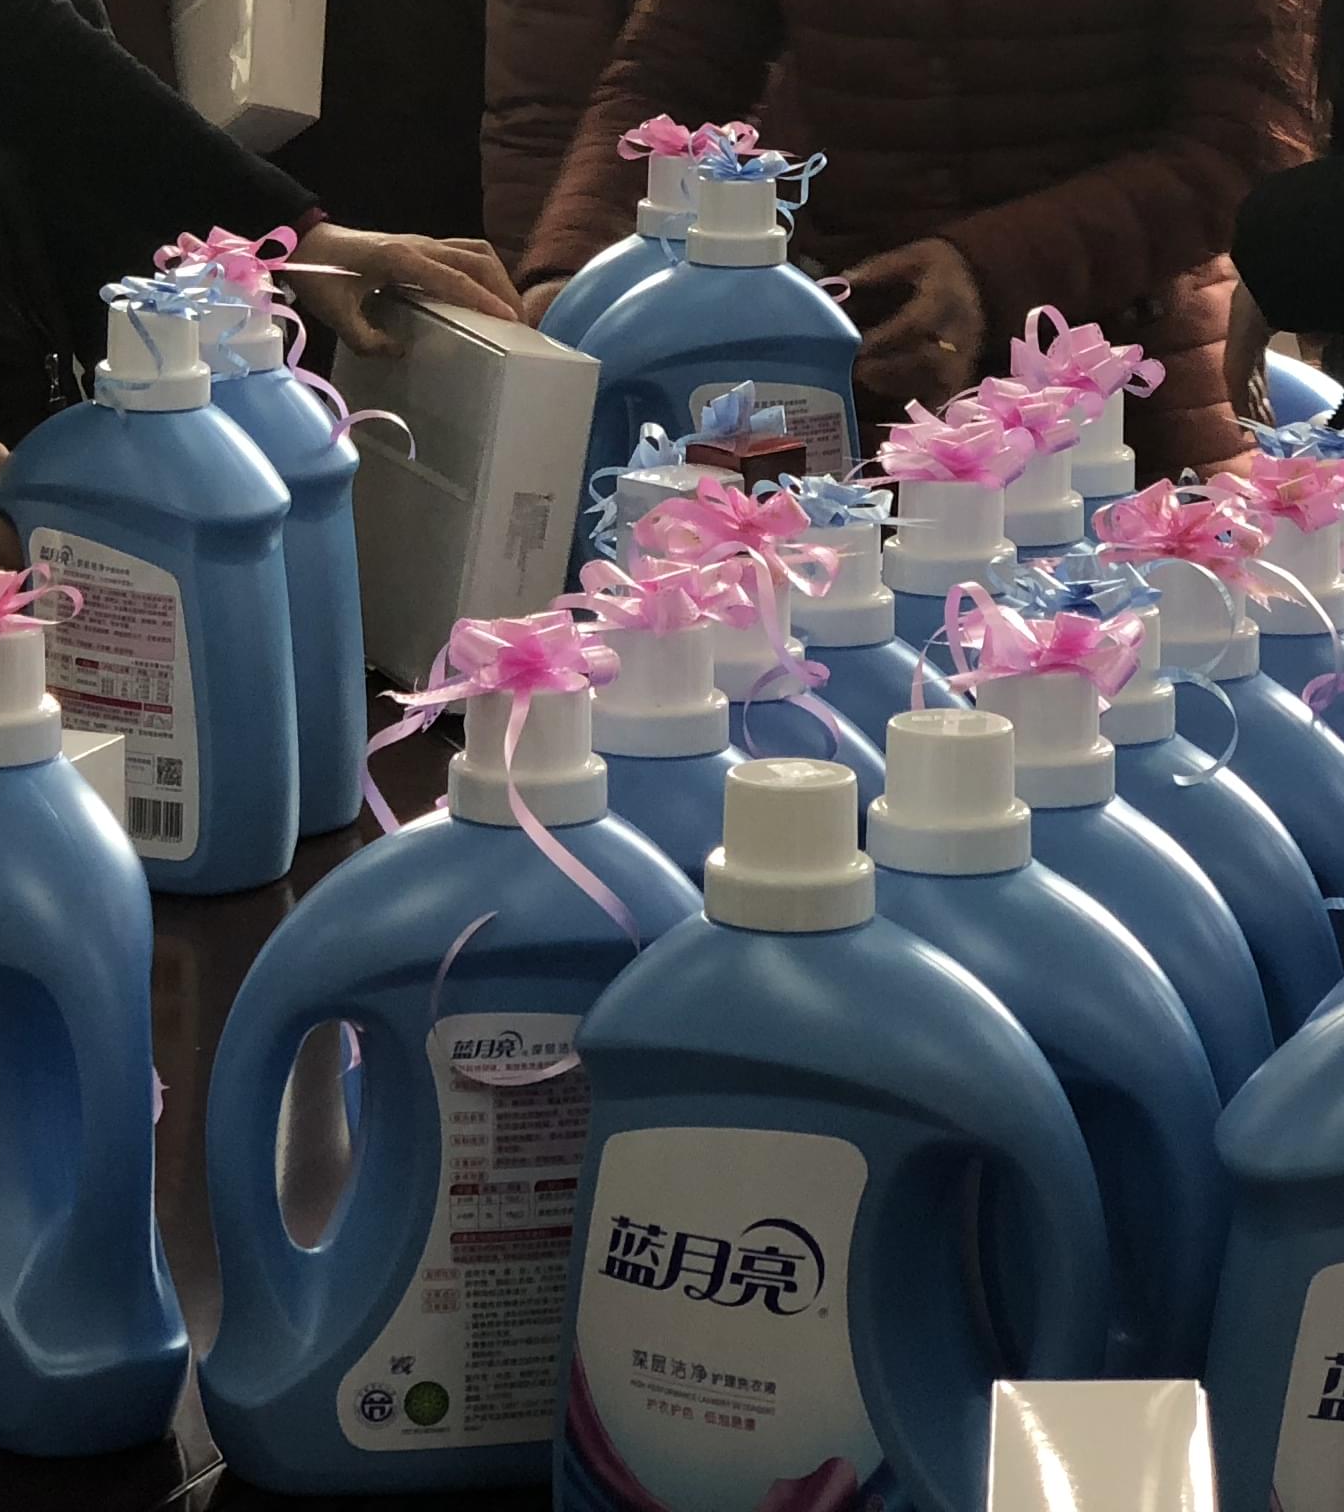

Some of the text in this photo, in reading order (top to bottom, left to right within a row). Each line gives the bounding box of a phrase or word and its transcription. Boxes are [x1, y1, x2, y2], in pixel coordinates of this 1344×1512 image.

[452, 1030, 523, 1060] 蓝月亮
[598, 1215, 826, 1316] 蓝月亮
